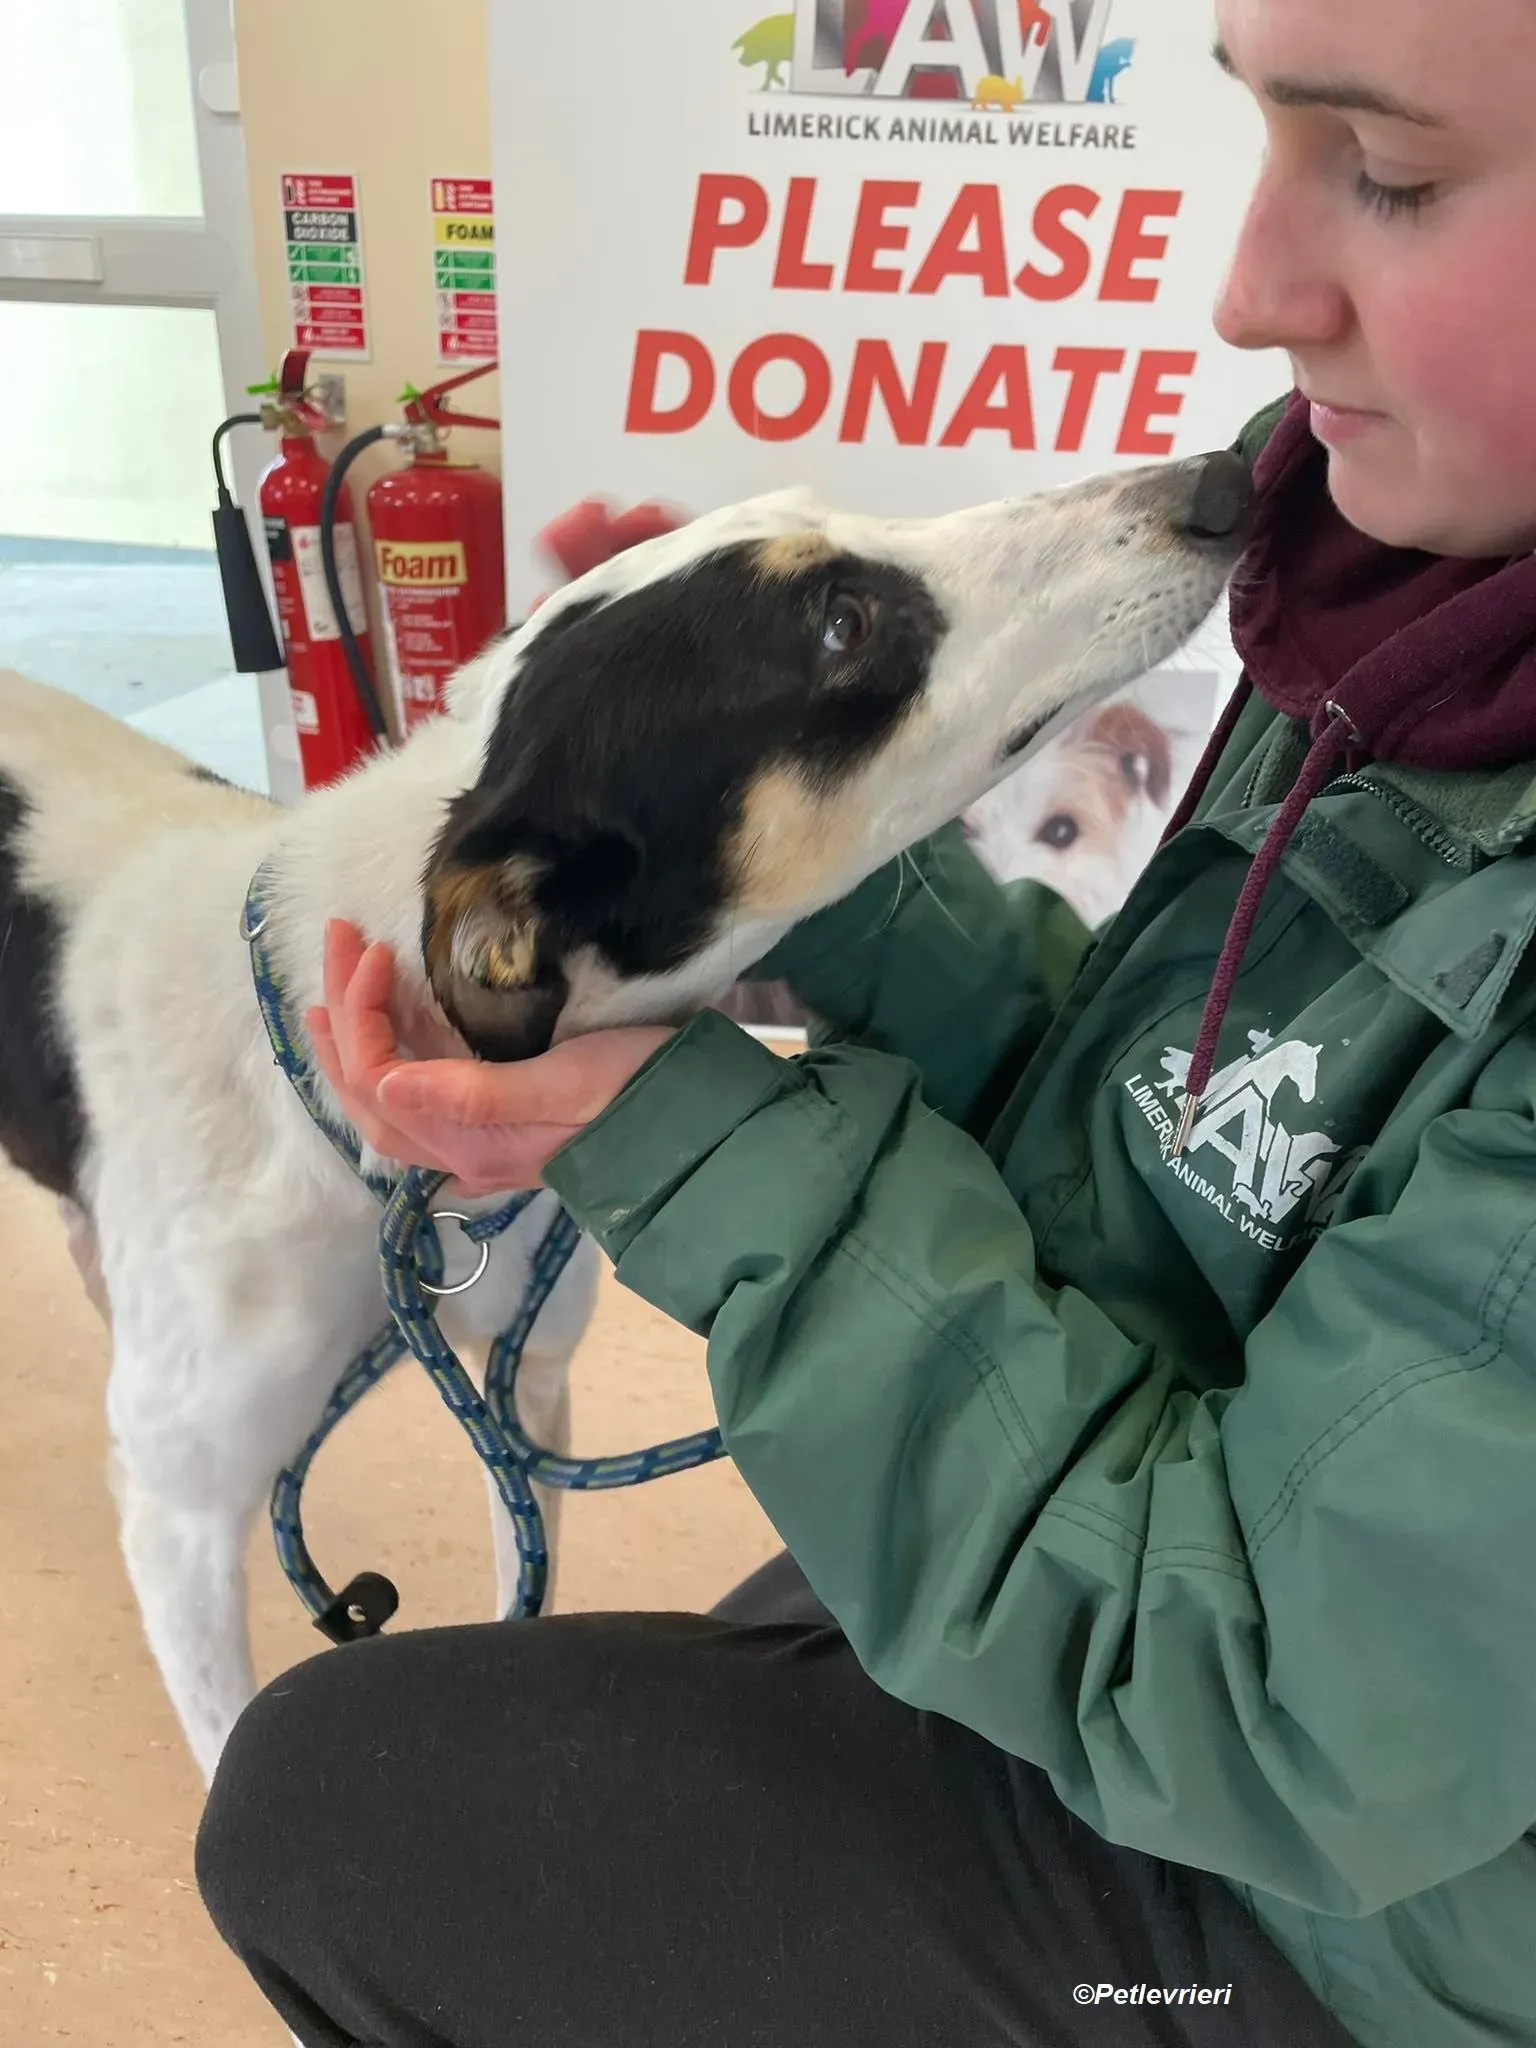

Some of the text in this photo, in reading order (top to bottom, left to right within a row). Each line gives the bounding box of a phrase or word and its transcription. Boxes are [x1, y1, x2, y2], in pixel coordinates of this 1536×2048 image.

[790, 0, 1112, 102] LAW
[747, 112, 1139, 149] LIMERICK ANIMAL WELFARE
[291, 211, 349, 226] CARBON
[446, 223, 495, 241] FOAM
[683, 172, 1184, 303] PLEASE
[623, 329, 1199, 456] DONATE
[381, 546, 457, 580] Foam
[1167, 1156, 1235, 1223] ANIMAL
